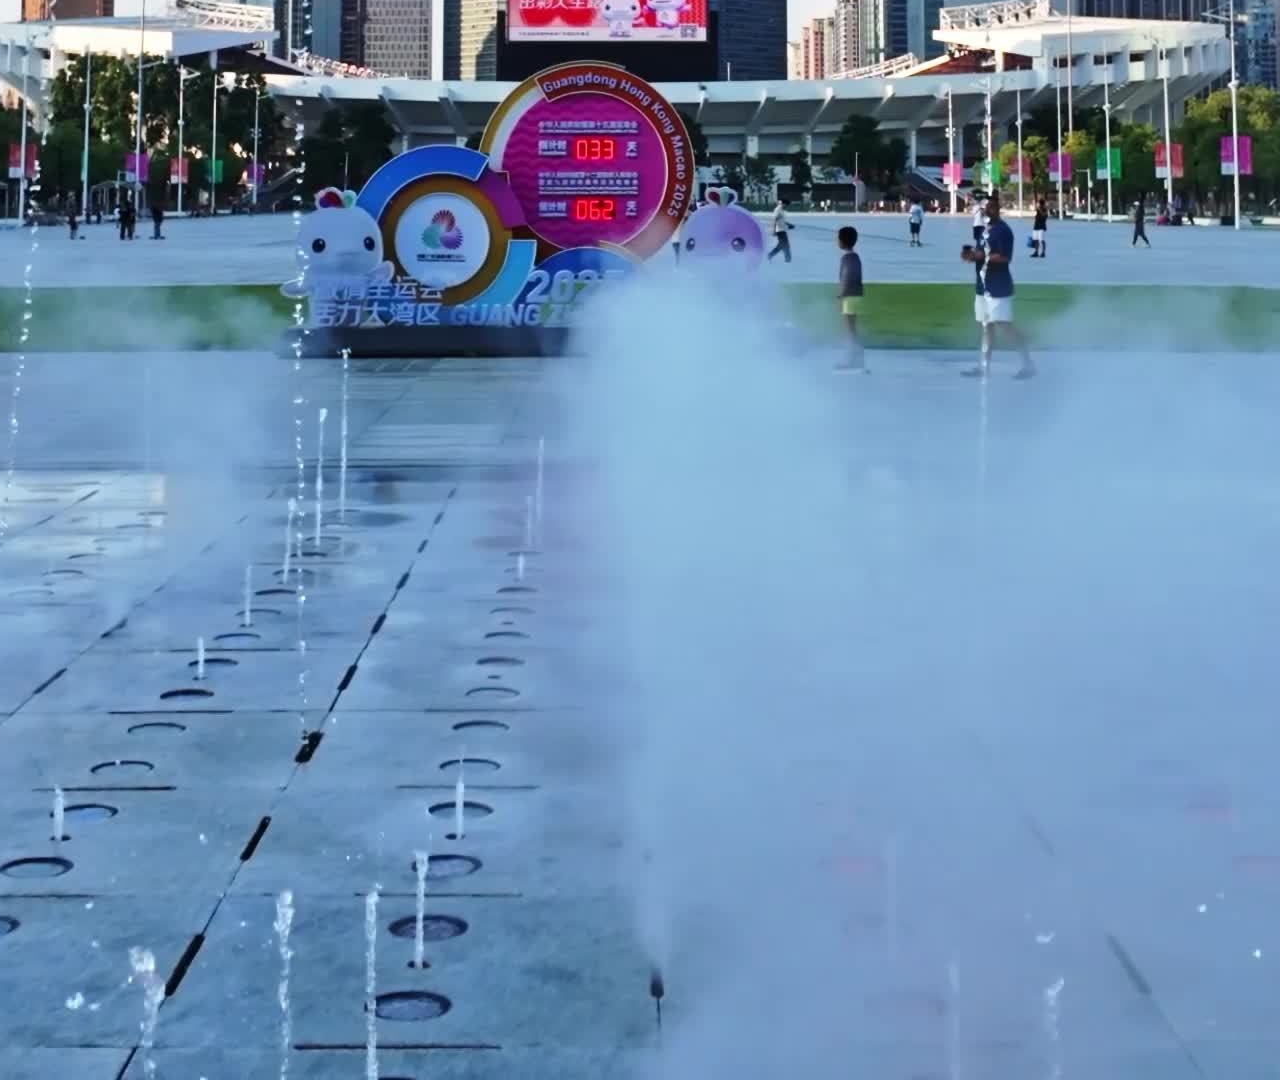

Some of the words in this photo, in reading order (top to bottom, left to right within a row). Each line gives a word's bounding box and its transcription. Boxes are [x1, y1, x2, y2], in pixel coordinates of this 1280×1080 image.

[543, 72, 617, 93] Guangdong
[620, 80, 651, 106] Hong
[651, 102, 674, 134] Kong
[577, 140, 614, 160] 033
[671, 135, 686, 179] Macao
[577, 200, 614, 220] 062
[667, 184, 686, 216] 2025
[526, 270, 626, 303] 202
